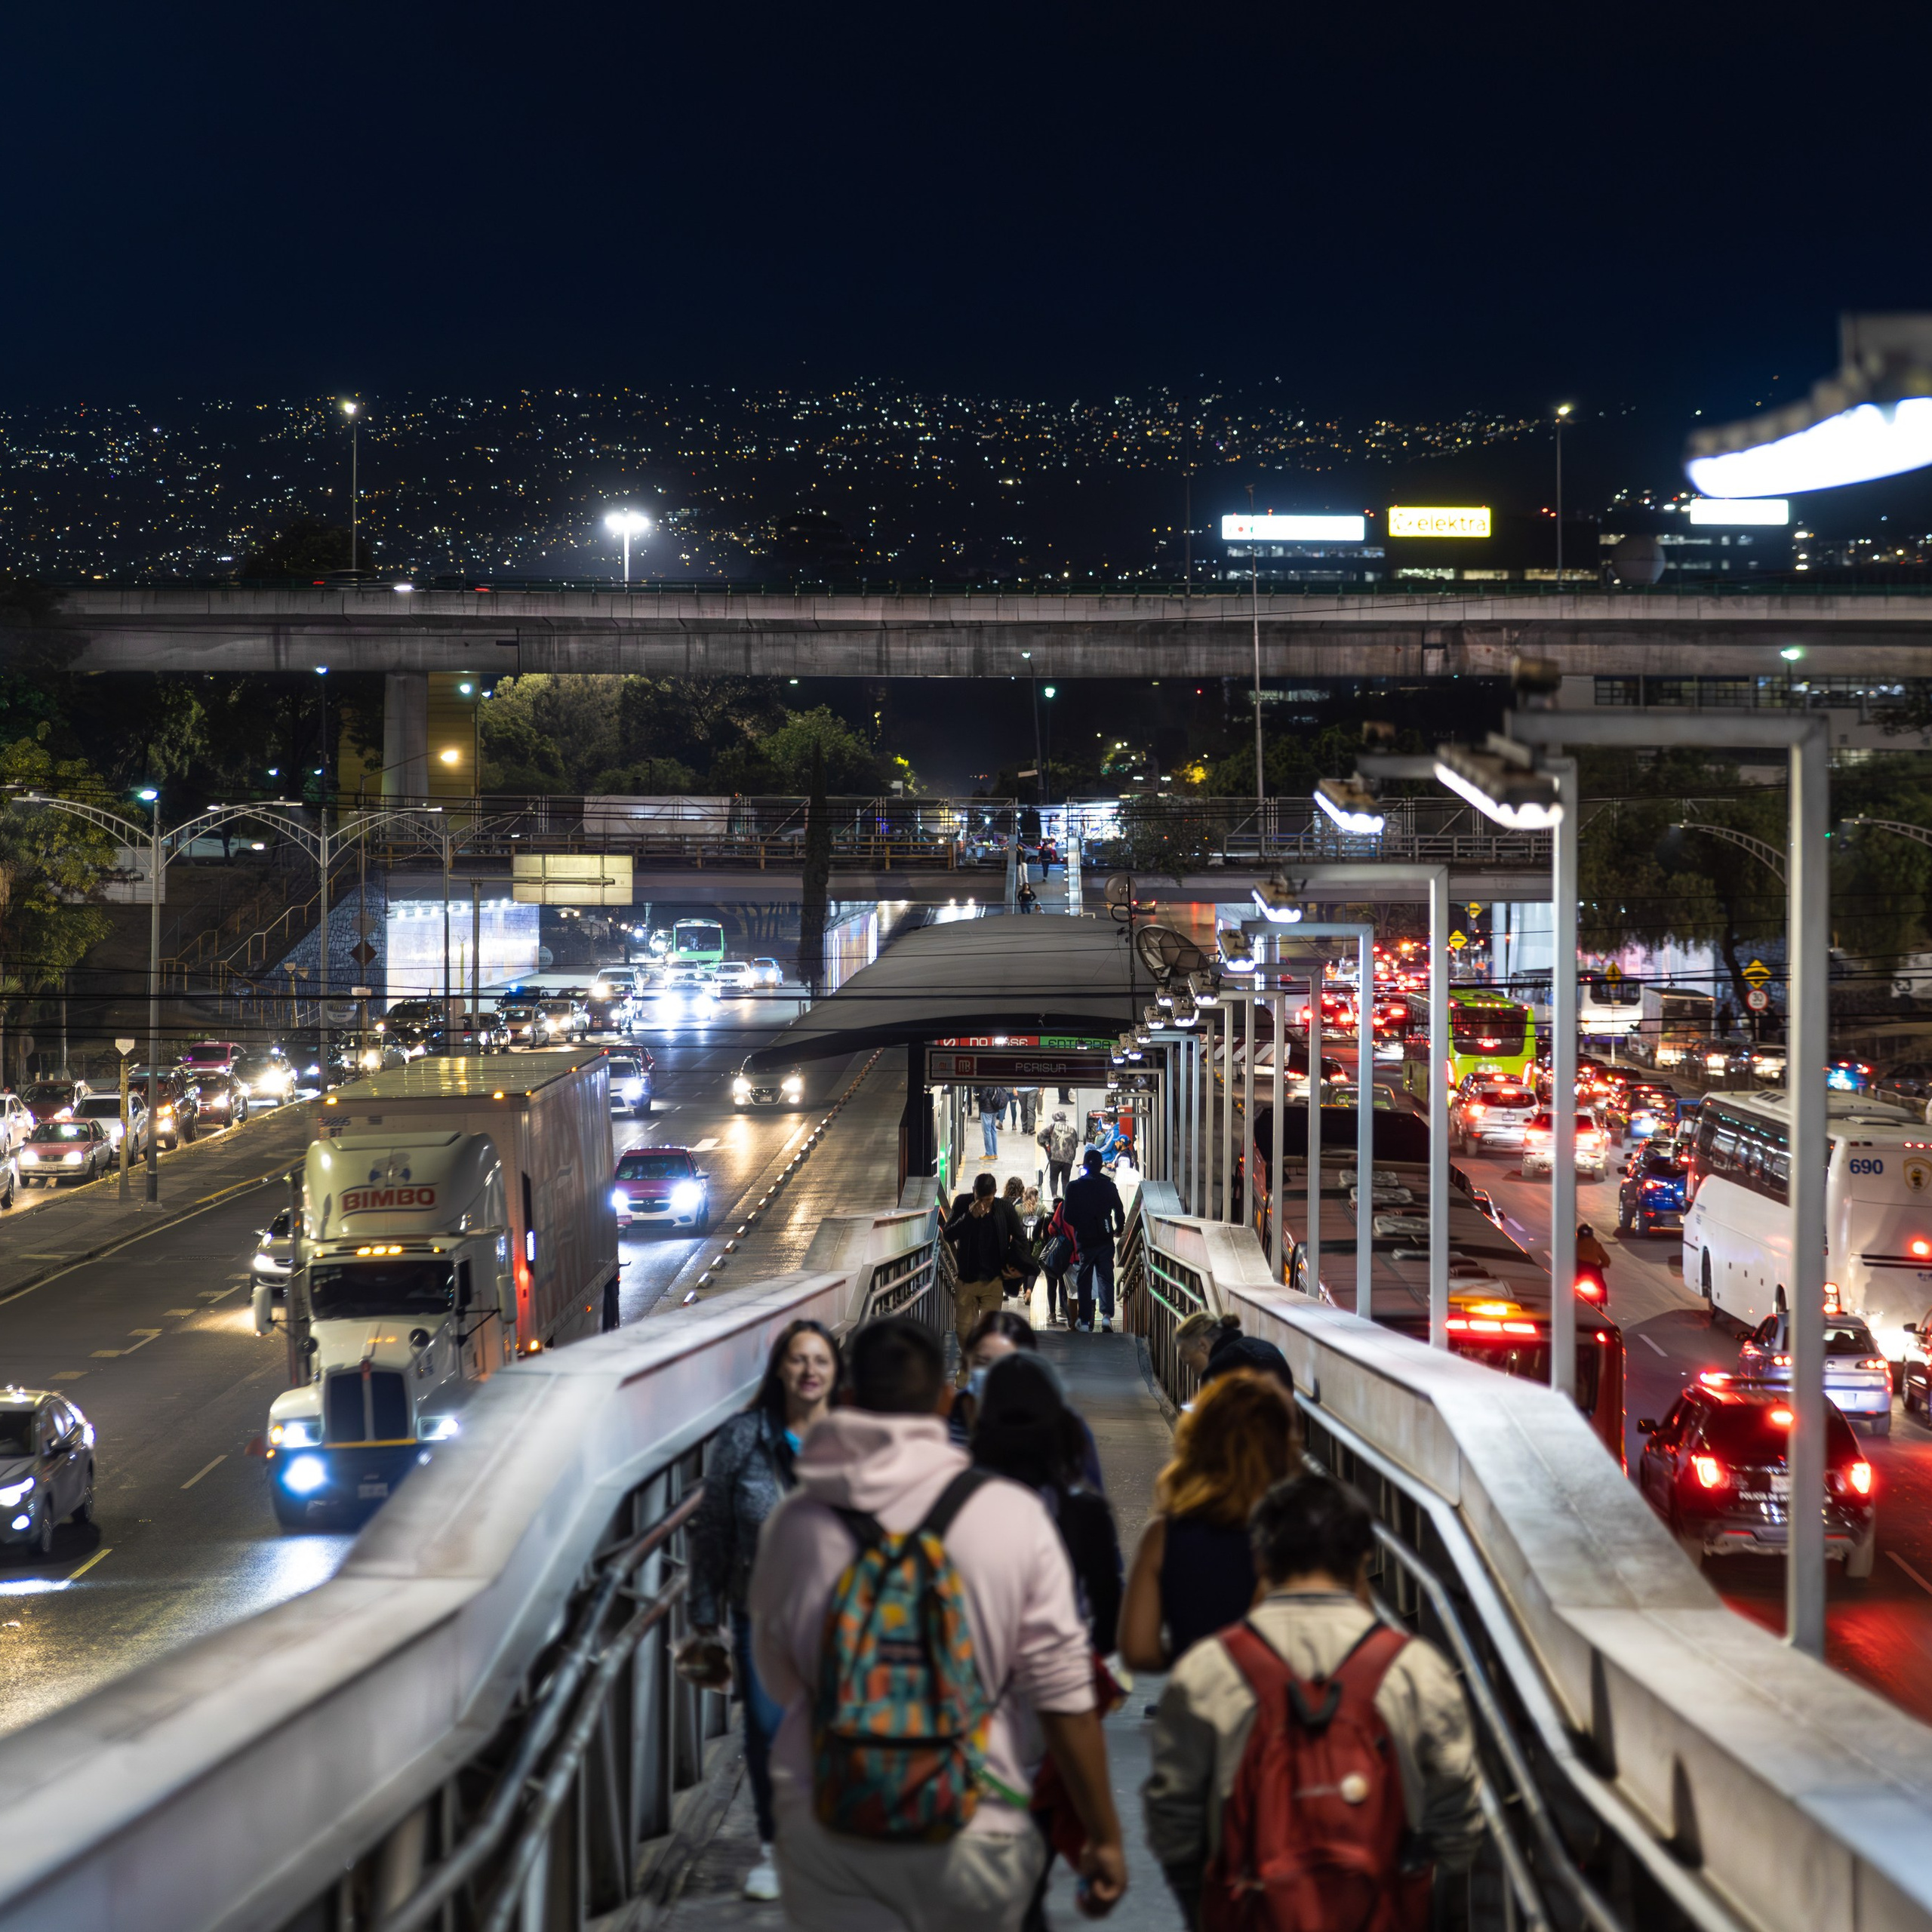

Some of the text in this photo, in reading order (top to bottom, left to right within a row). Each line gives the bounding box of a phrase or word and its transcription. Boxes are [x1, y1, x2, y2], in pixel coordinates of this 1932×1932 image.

[1418, 515, 1486, 531] elektra
[970, 1038, 988, 1047] NO
[1015, 1062, 1066, 1073] PERISUR
[1849, 1158, 1884, 1175] 690
[342, 1187, 436, 1213] BIMBO
